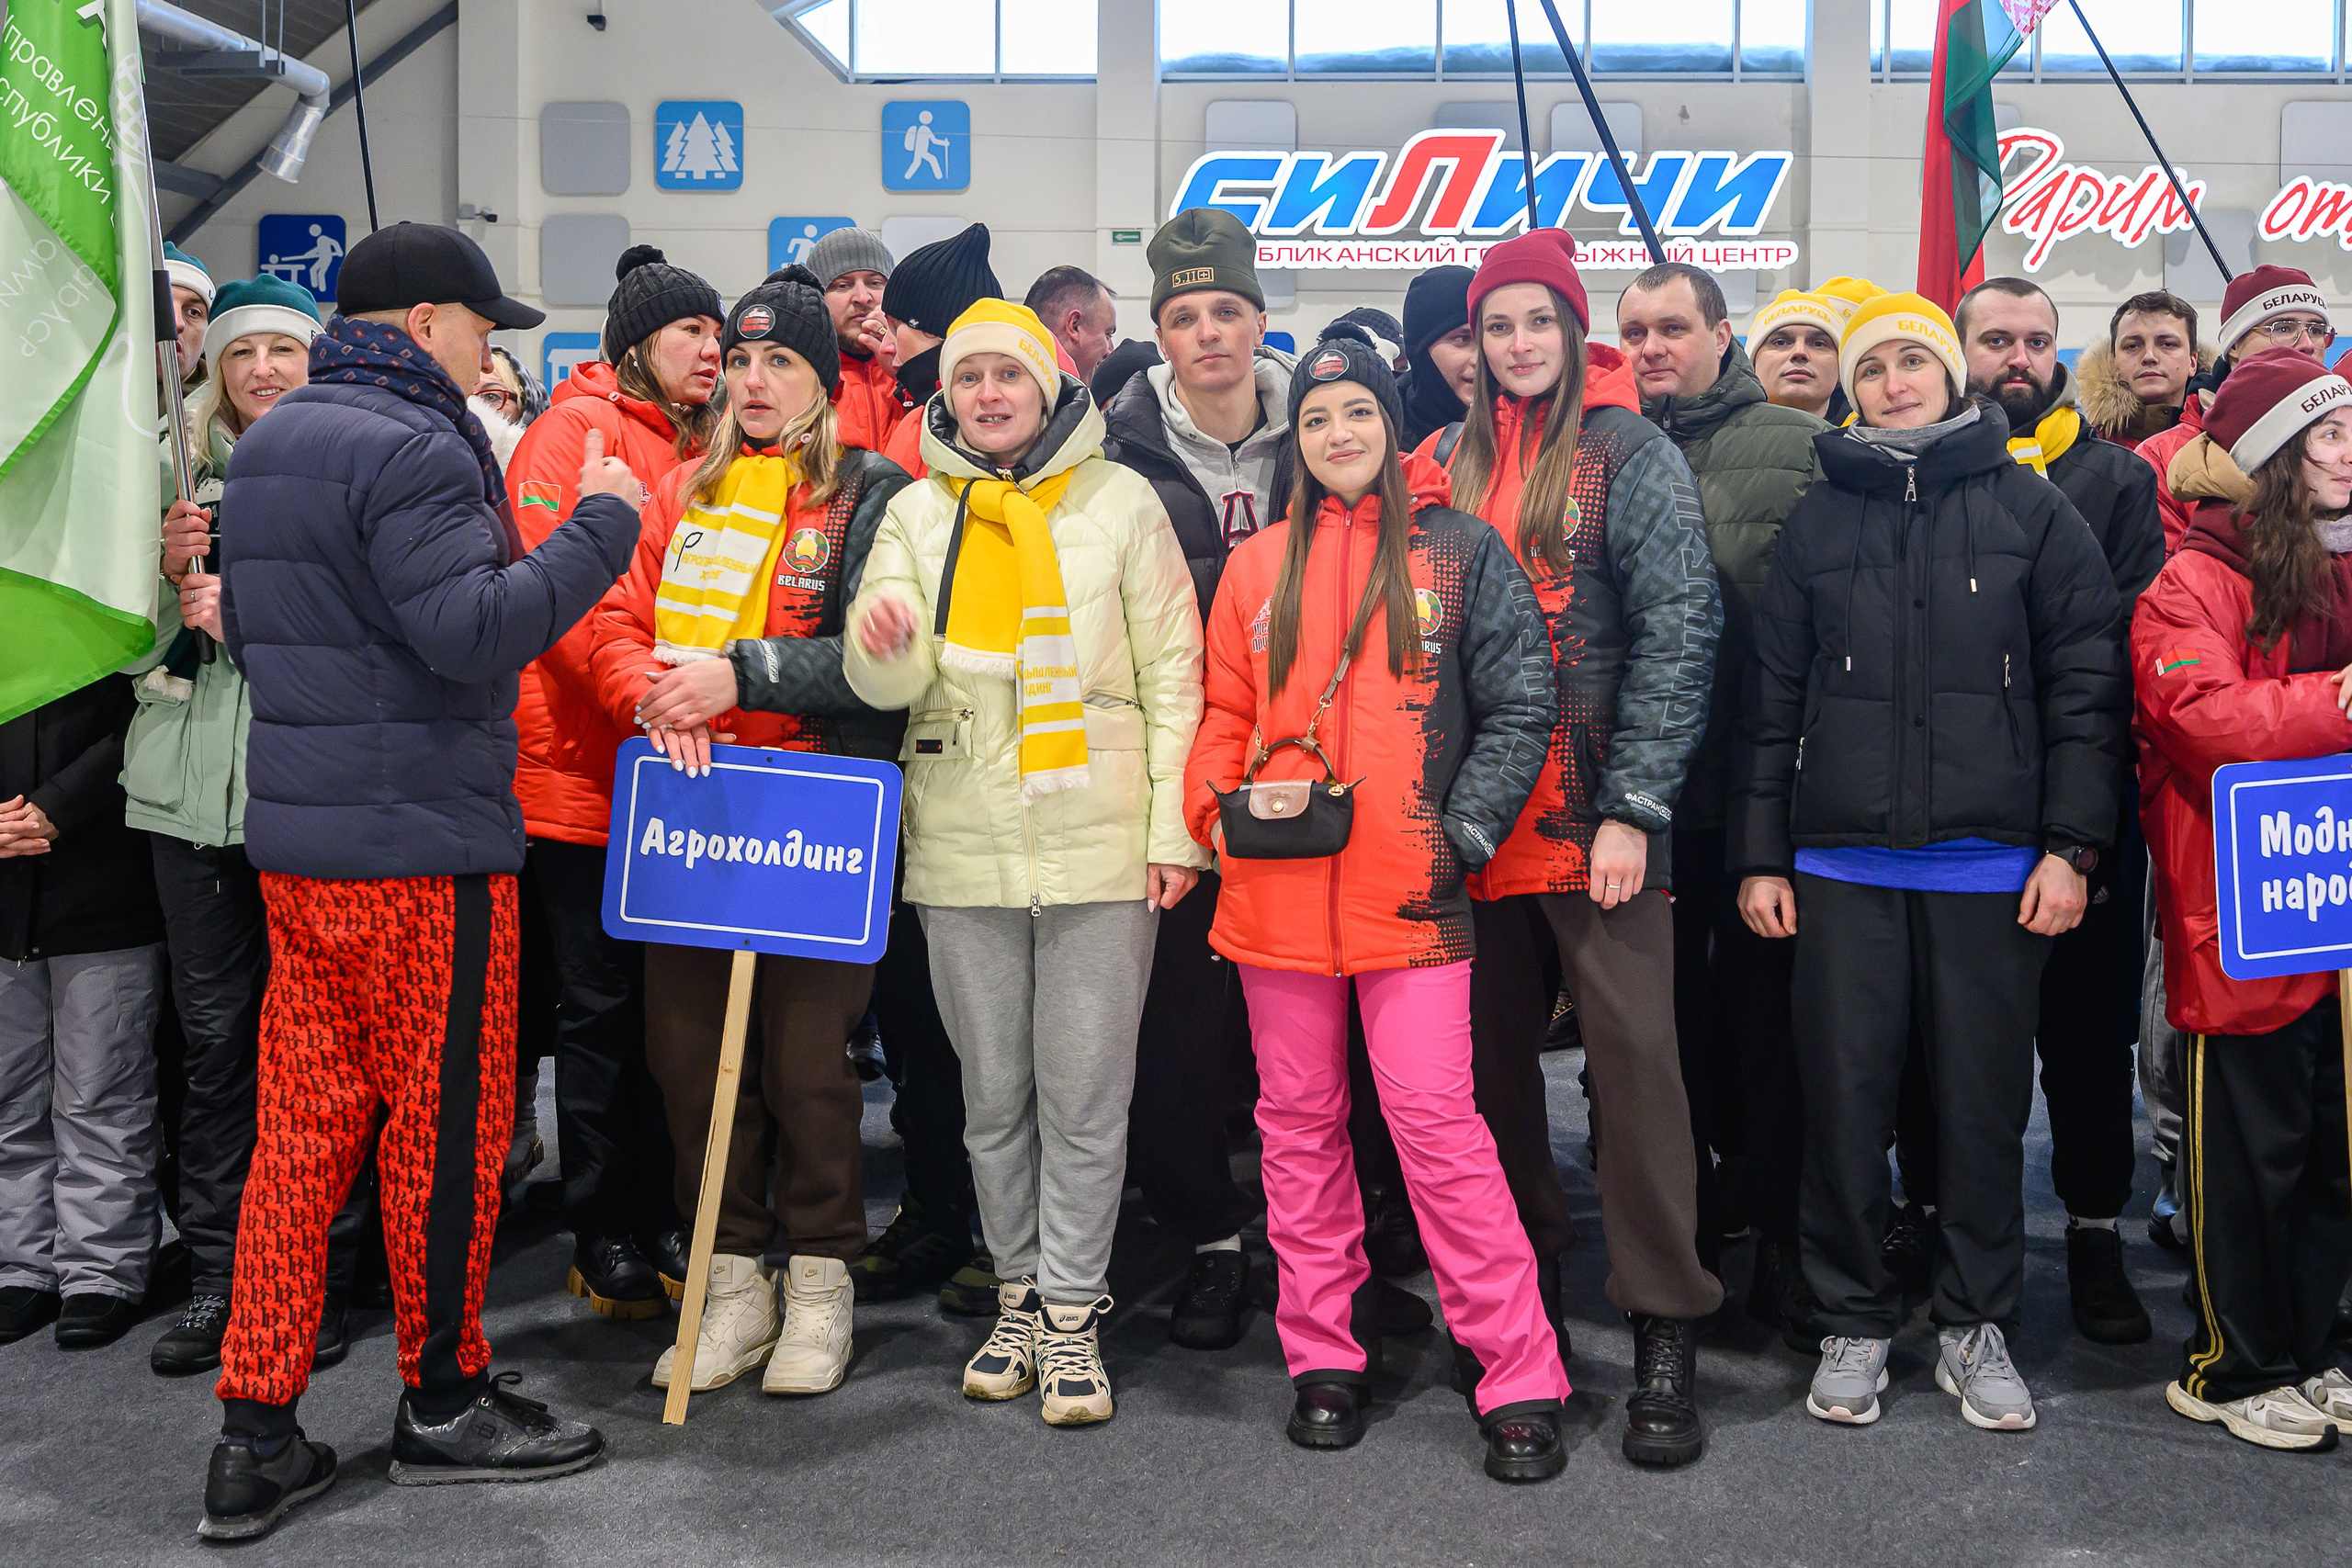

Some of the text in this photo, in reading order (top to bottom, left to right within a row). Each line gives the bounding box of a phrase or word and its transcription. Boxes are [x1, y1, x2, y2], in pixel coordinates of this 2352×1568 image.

[4, 14, 112, 151] правлен
[1173, 132, 1790, 231] СИЛИЧИ
[2265, 183, 2352, 244] от
[1702, 247, 1792, 265] ЦЕНТР
[1763, 304, 1831, 326] БЕЛАРУСЬ
[1897, 320, 1962, 371] БЕЛАРУСЬ
[639, 817, 864, 874] Агрохолдинг
